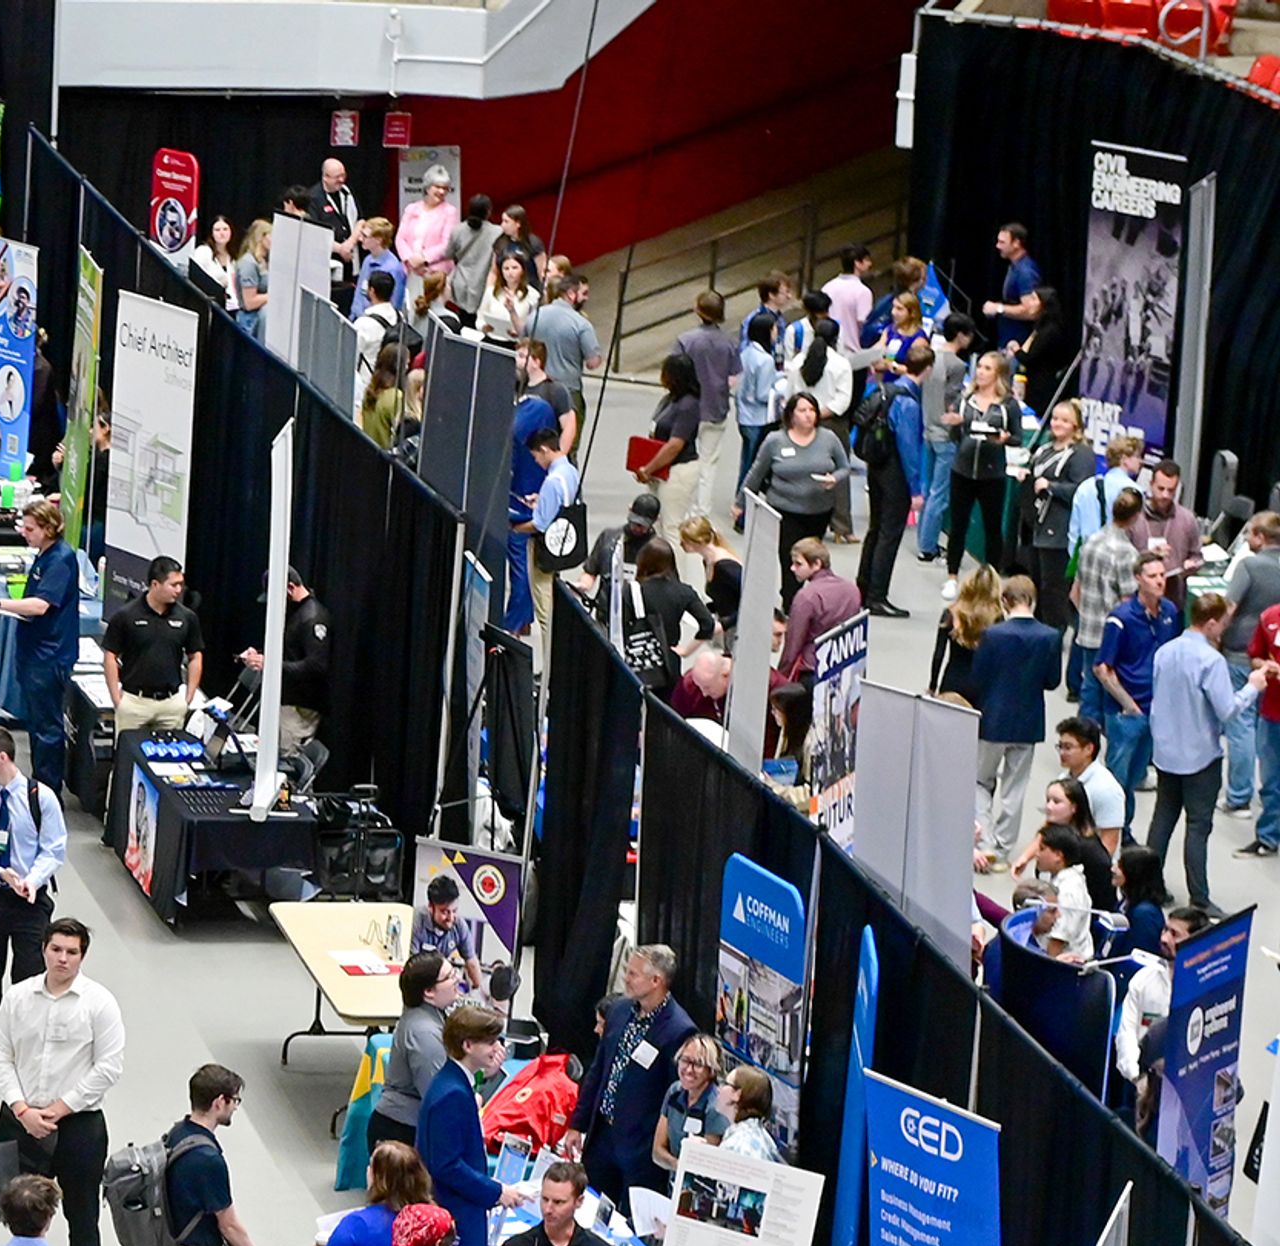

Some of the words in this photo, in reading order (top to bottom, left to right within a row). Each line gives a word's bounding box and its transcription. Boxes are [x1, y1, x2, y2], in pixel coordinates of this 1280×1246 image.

[1093, 152, 1130, 177] CIVIL
[1091, 190, 1157, 220] CAREERS
[1092, 170, 1182, 205] ENGINEERING
[119, 321, 148, 354] Chief
[149, 331, 193, 369] Architect
[831, 623, 867, 667] ANVIL
[744, 911, 790, 950] ENGINEERS
[746, 894, 790, 934] COFFMAN
[900, 1106, 963, 1162] CED
[881, 1156, 909, 1182] WHERE
[909, 1170, 918, 1187] DO
[919, 1174, 936, 1195] YOU
[937, 1183, 959, 1203] FIT?
[881, 1189, 908, 1213] Business
[908, 1202, 951, 1233] Management
[881, 1208, 901, 1229] Credit
[881, 1227, 898, 1246] Sales
